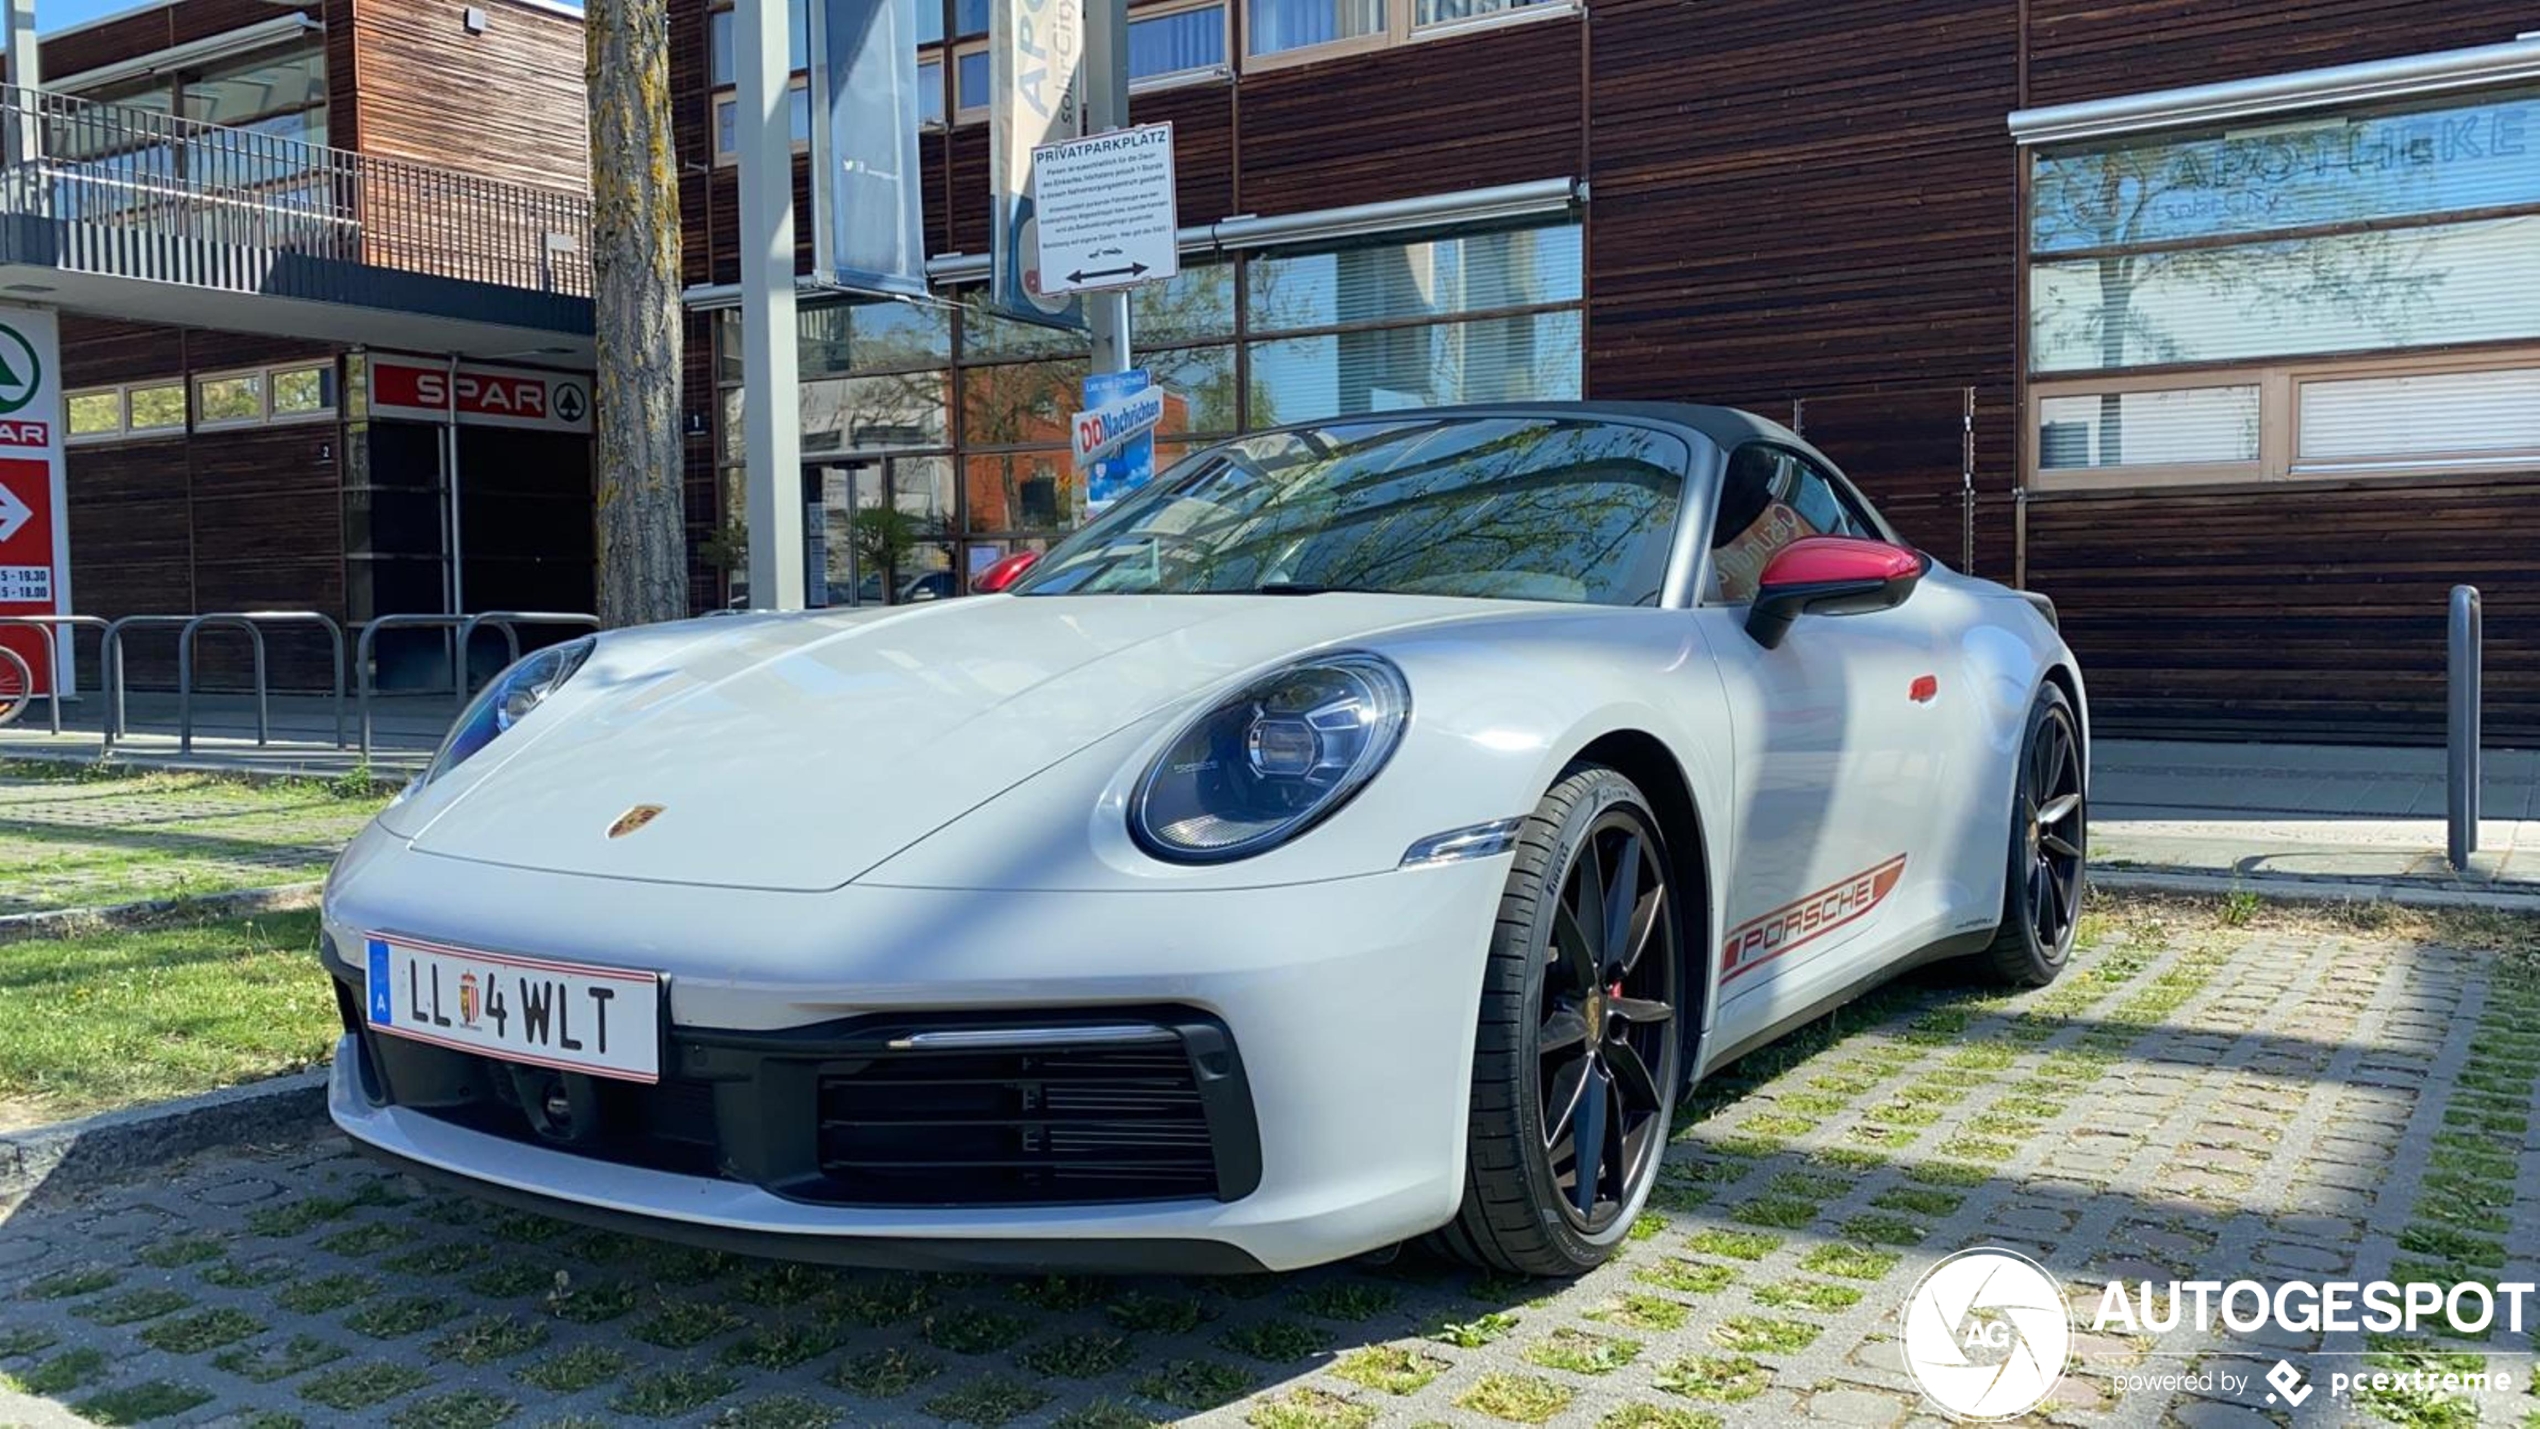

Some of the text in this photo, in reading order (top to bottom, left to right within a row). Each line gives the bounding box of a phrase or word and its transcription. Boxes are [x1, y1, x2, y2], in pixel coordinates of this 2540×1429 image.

[1035, 130, 1167, 165] PRIVATPARKPLATZ
[416, 374, 544, 413] SPAR
[322, 445, 330, 458] 2
[18, 570, 47, 581] 19.30
[1740, 876, 1873, 961] PORSCHE
[376, 993, 387, 1013] A
[410, 958, 451, 1027] LL
